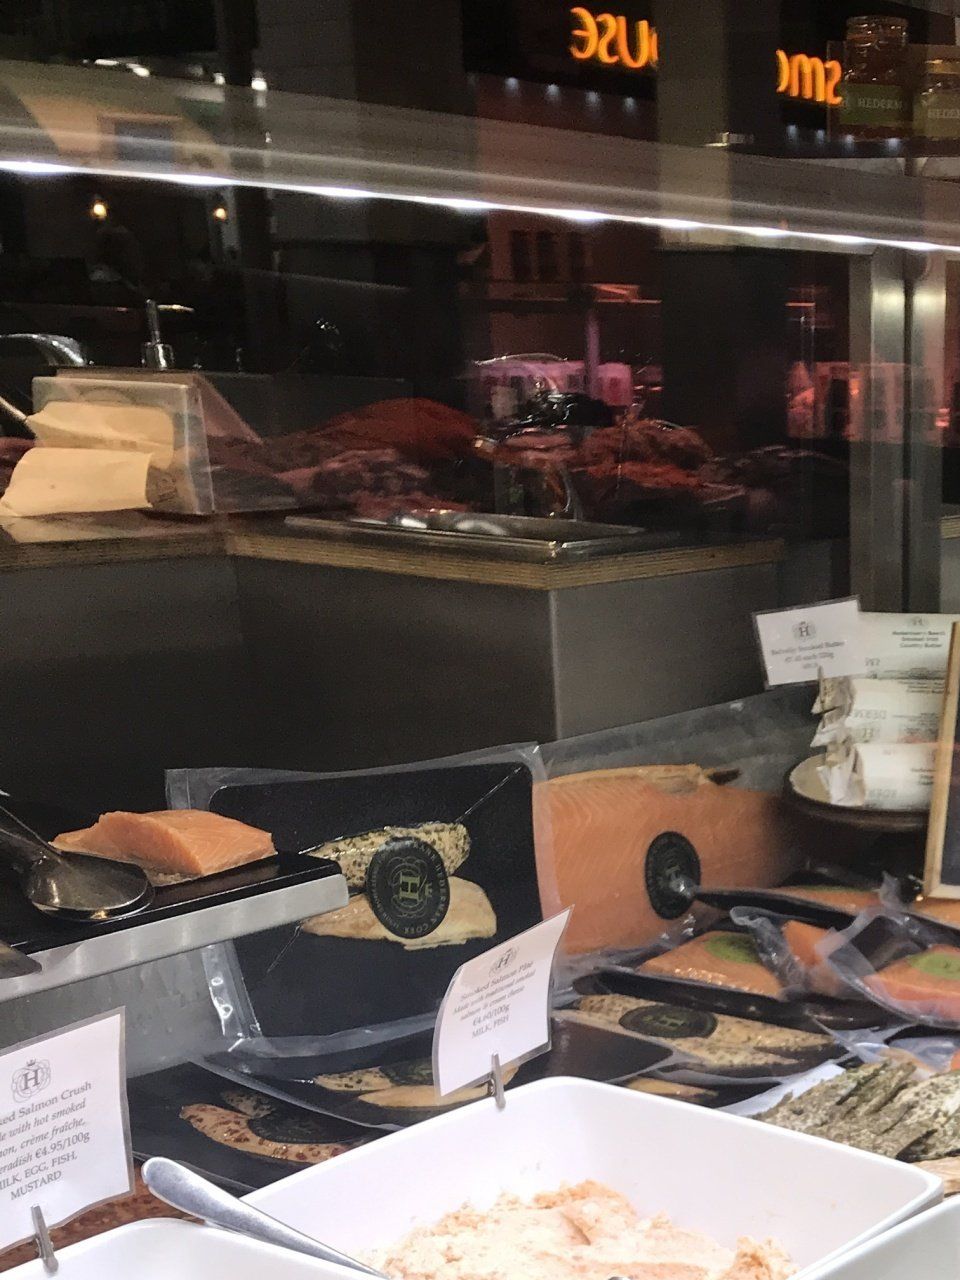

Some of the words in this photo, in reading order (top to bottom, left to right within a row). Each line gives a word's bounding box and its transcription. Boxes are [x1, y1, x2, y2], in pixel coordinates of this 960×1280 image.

[19, 1096, 58, 1118] Salmon
[60, 1080, 92, 1100] Crush
[9, 1122, 31, 1138] with
[34, 1114, 49, 1127] hot
[51, 1098, 87, 1121] smoked
[20, 1131, 49, 1149] crème
[35, 1131, 91, 1159] €4.95/100g
[10, 1170, 62, 1200] MUSTARD
